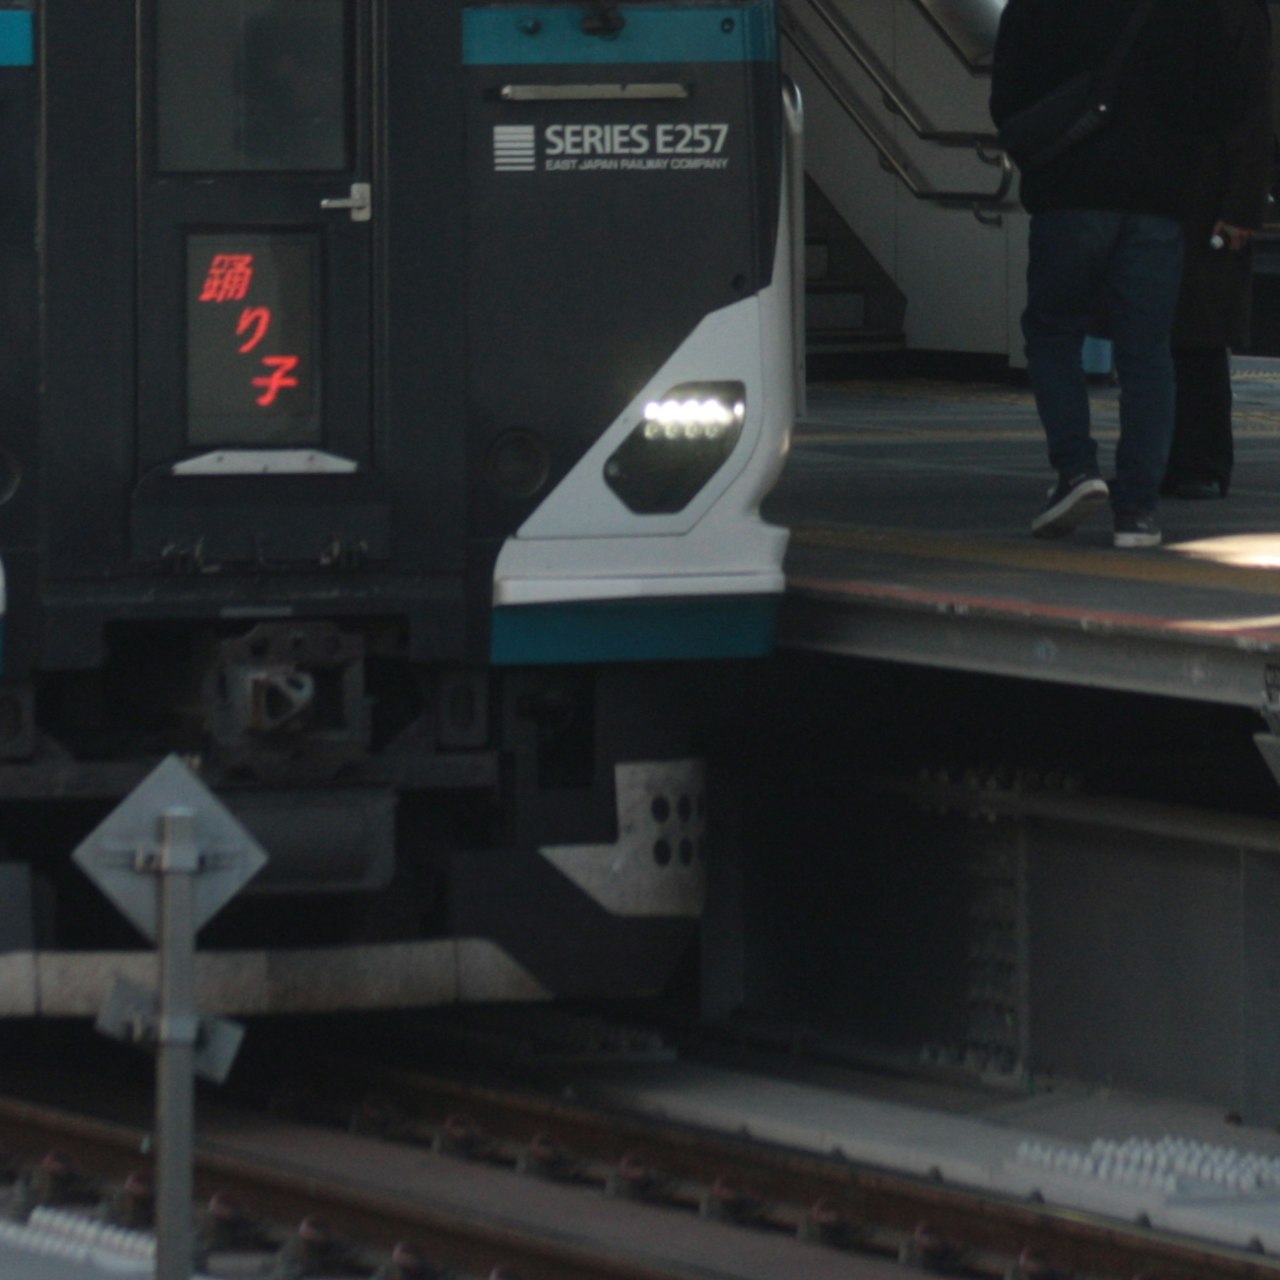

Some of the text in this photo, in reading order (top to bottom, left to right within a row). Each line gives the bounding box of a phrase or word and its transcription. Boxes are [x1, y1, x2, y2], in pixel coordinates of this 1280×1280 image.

[545, 123, 730, 155] SERIES E257
[545, 158, 730, 171] EAST JAPAN RAILWAY COMPANY
[198, 253, 302, 407] 踊り子
